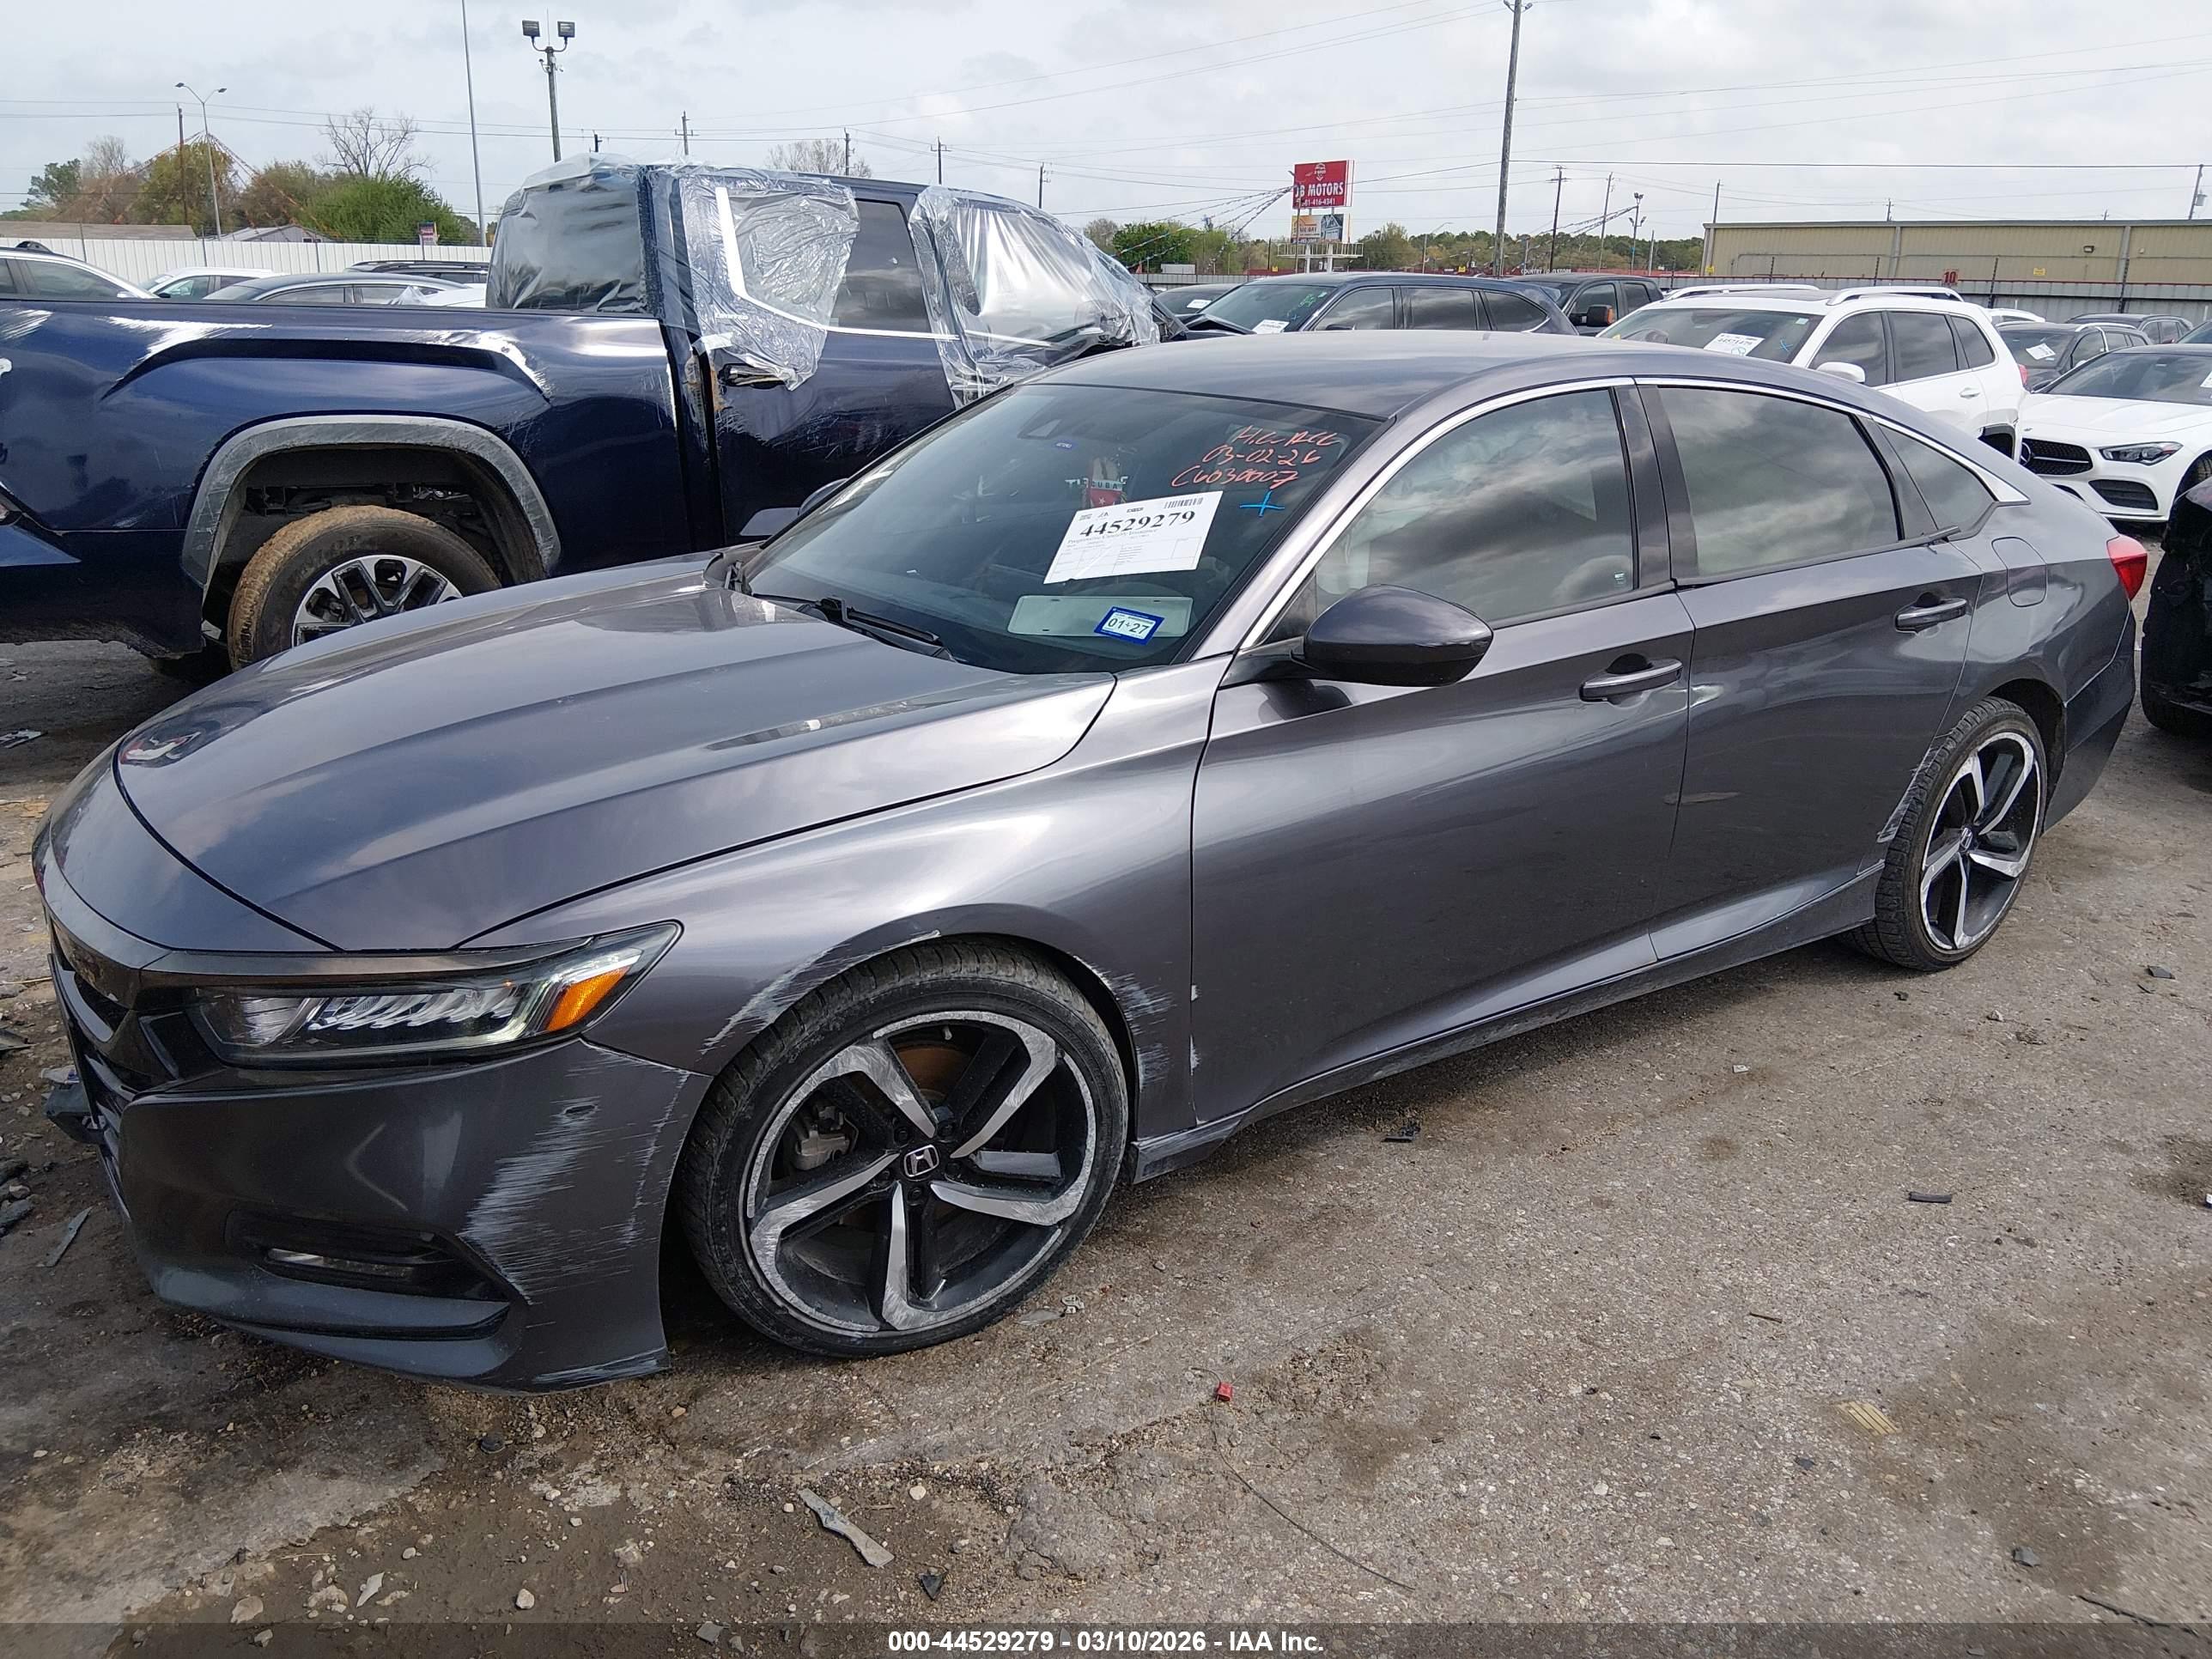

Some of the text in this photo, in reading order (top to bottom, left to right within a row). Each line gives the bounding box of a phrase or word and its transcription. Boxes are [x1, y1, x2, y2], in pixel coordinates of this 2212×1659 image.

[1295, 182, 1344, 198] JB MOTORS
[1944, 271, 1957, 283] 10
[1091, 480, 1118, 489] CUBA
[1079, 510, 1196, 538] 44529279
